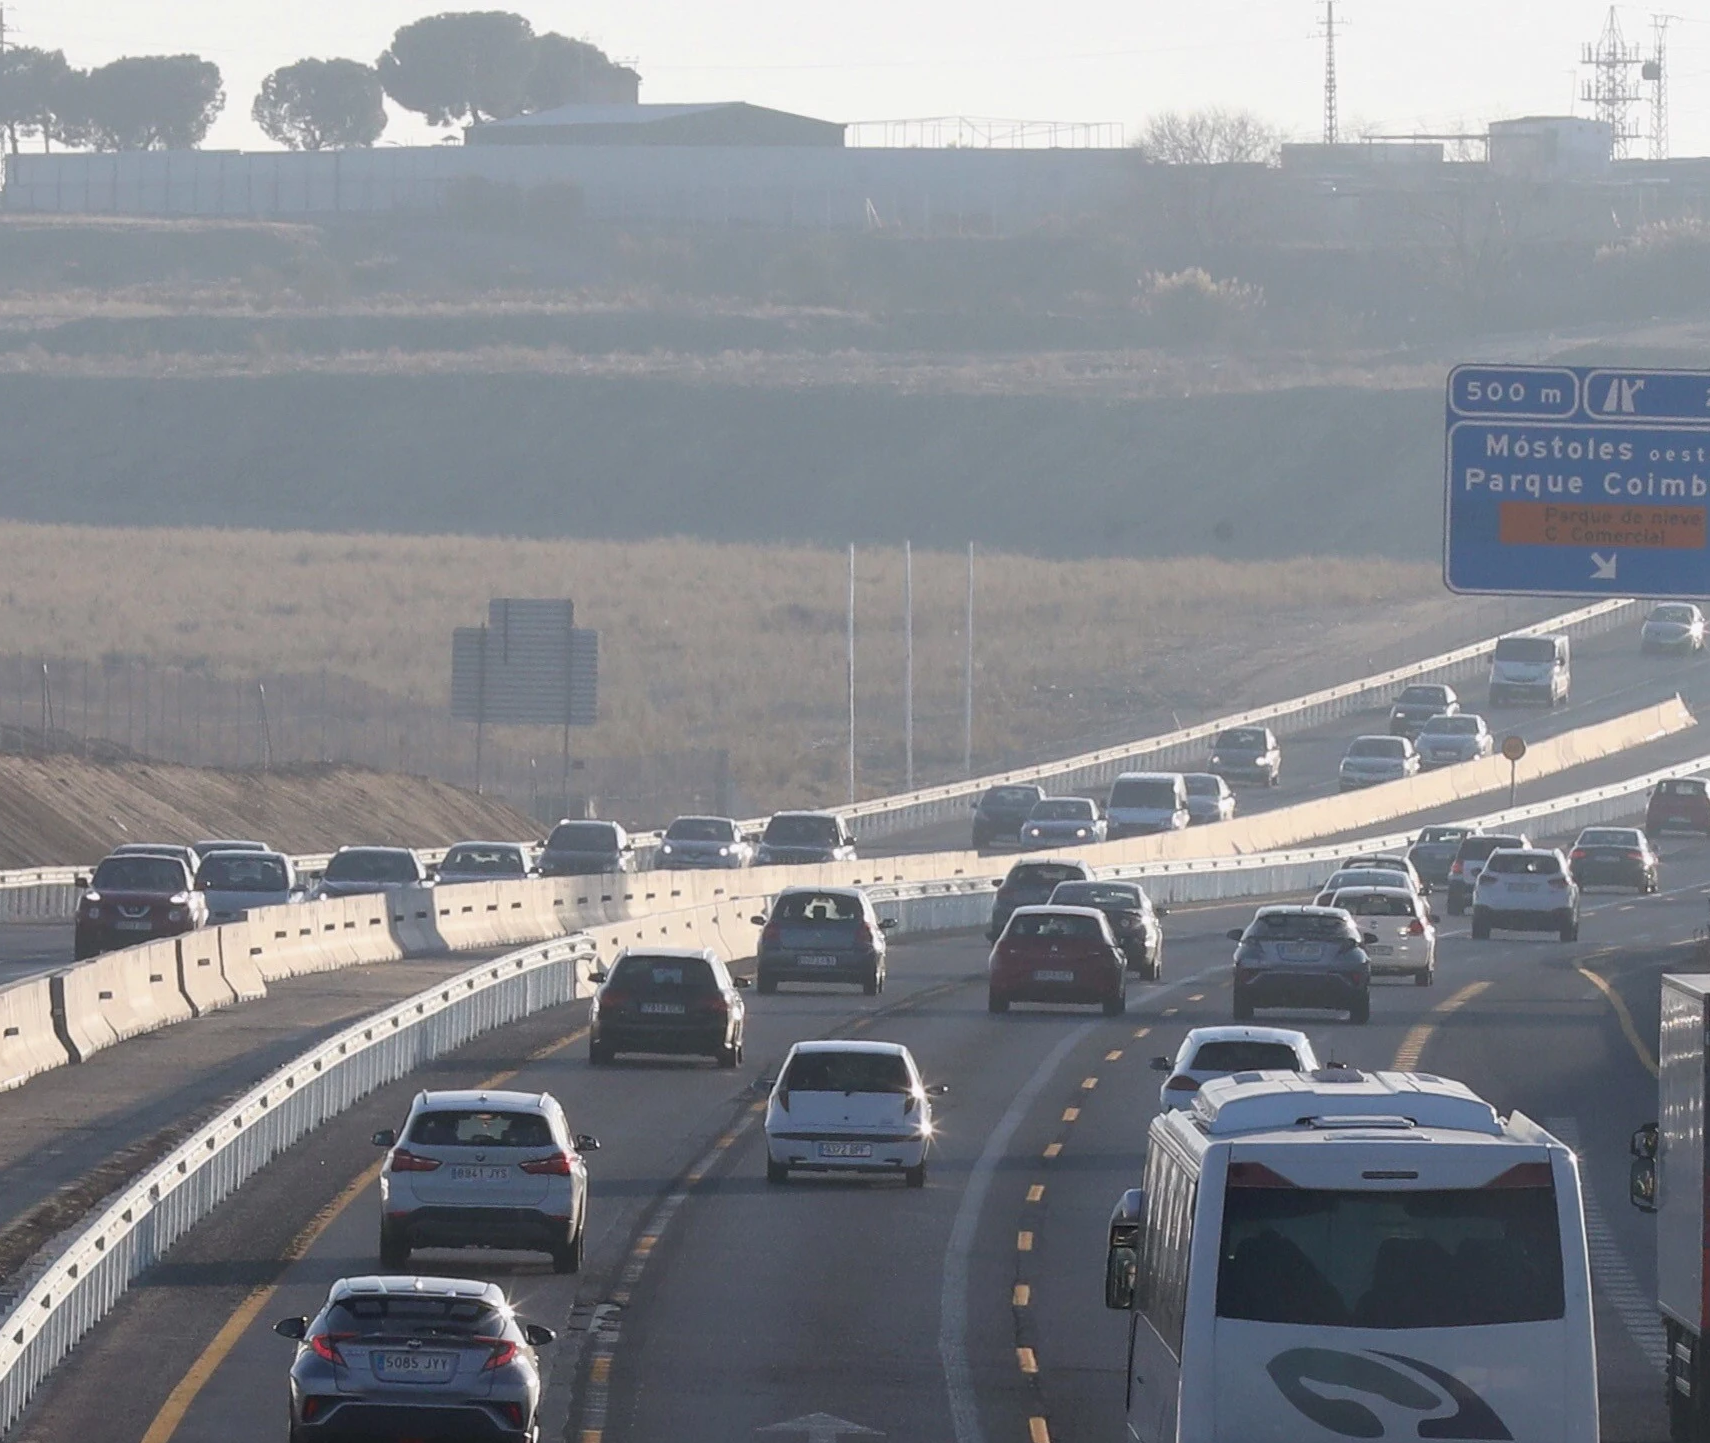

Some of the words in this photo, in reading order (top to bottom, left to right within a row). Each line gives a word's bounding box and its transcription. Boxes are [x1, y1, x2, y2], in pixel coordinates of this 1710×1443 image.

[1467, 381, 1525, 402] 500
[1541, 387, 1562, 404] m
[1486, 433, 1633, 461] Móstoles
[1464, 467, 1584, 499] Parque
[1544, 506, 1611, 527] Parque
[1620, 508, 1642, 525] de
[1651, 510, 1701, 527] nieve
[1571, 526, 1666, 545] Comercial
[385, 1356, 420, 1369] 5085
